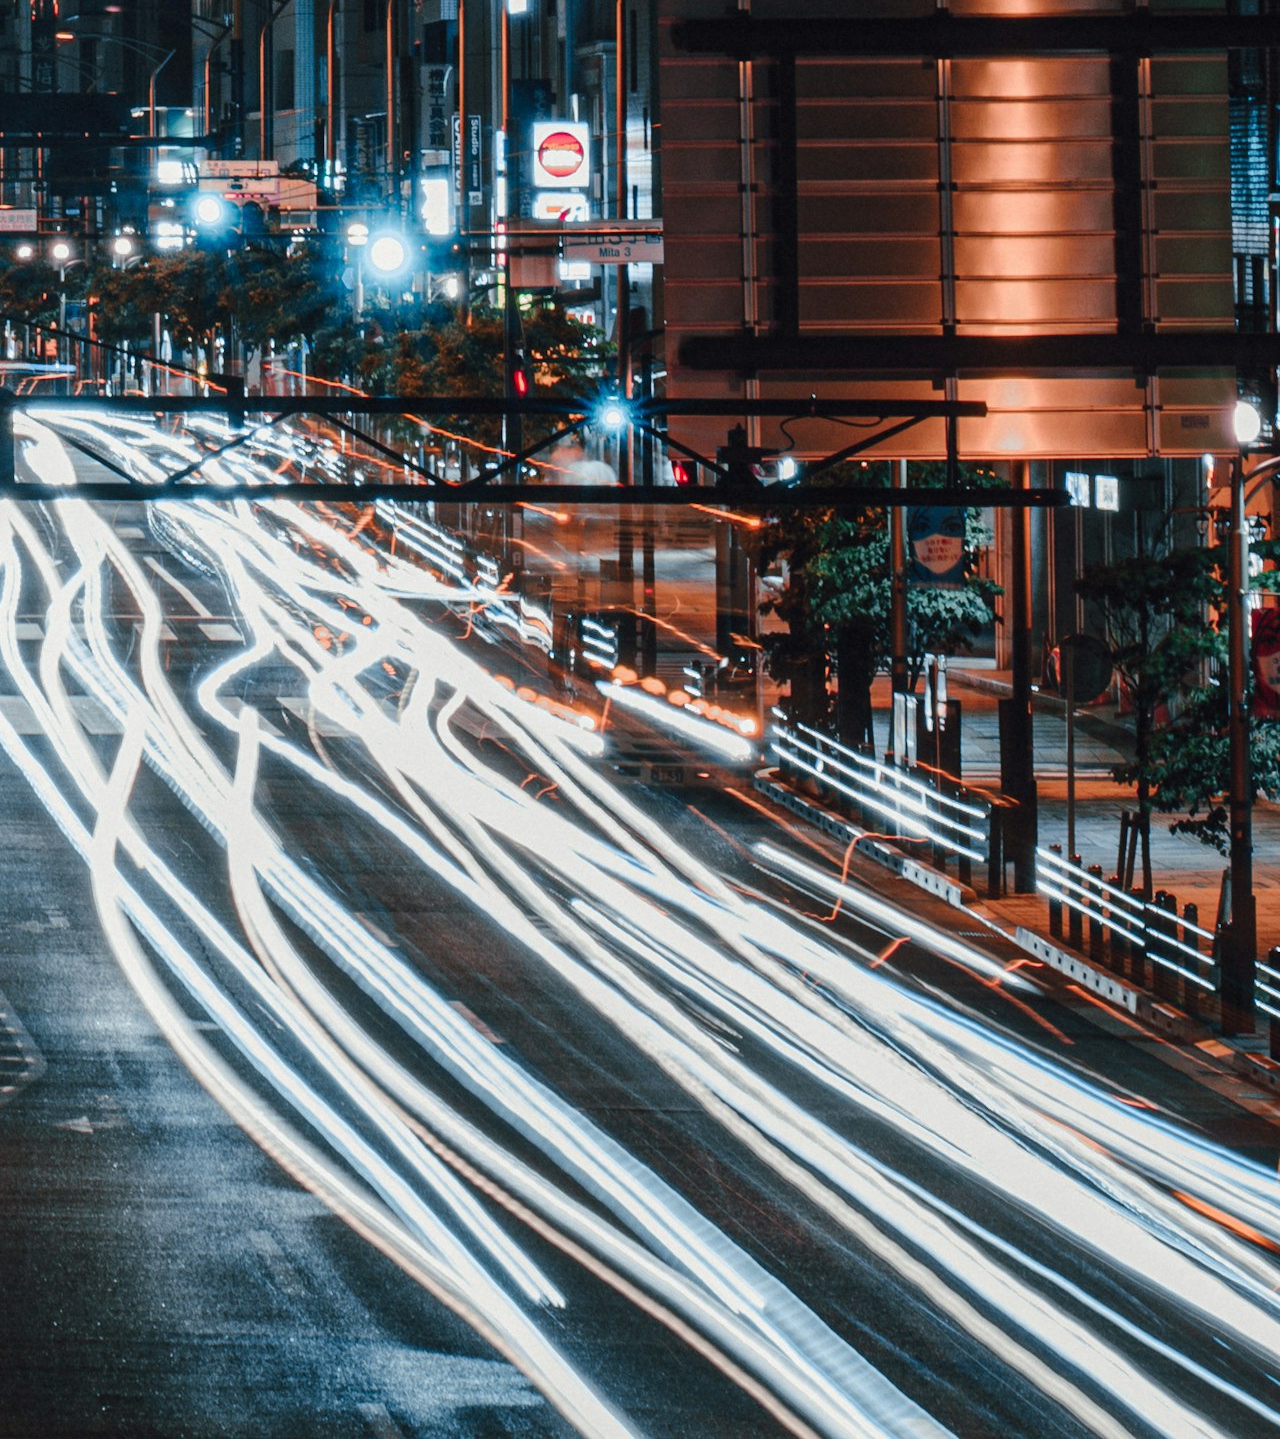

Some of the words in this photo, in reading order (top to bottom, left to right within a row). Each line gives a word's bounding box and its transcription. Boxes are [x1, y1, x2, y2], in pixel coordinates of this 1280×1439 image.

[471, 119, 479, 156] Studio
[599, 247, 621, 257] Mita
[624, 247, 632, 257] 3
